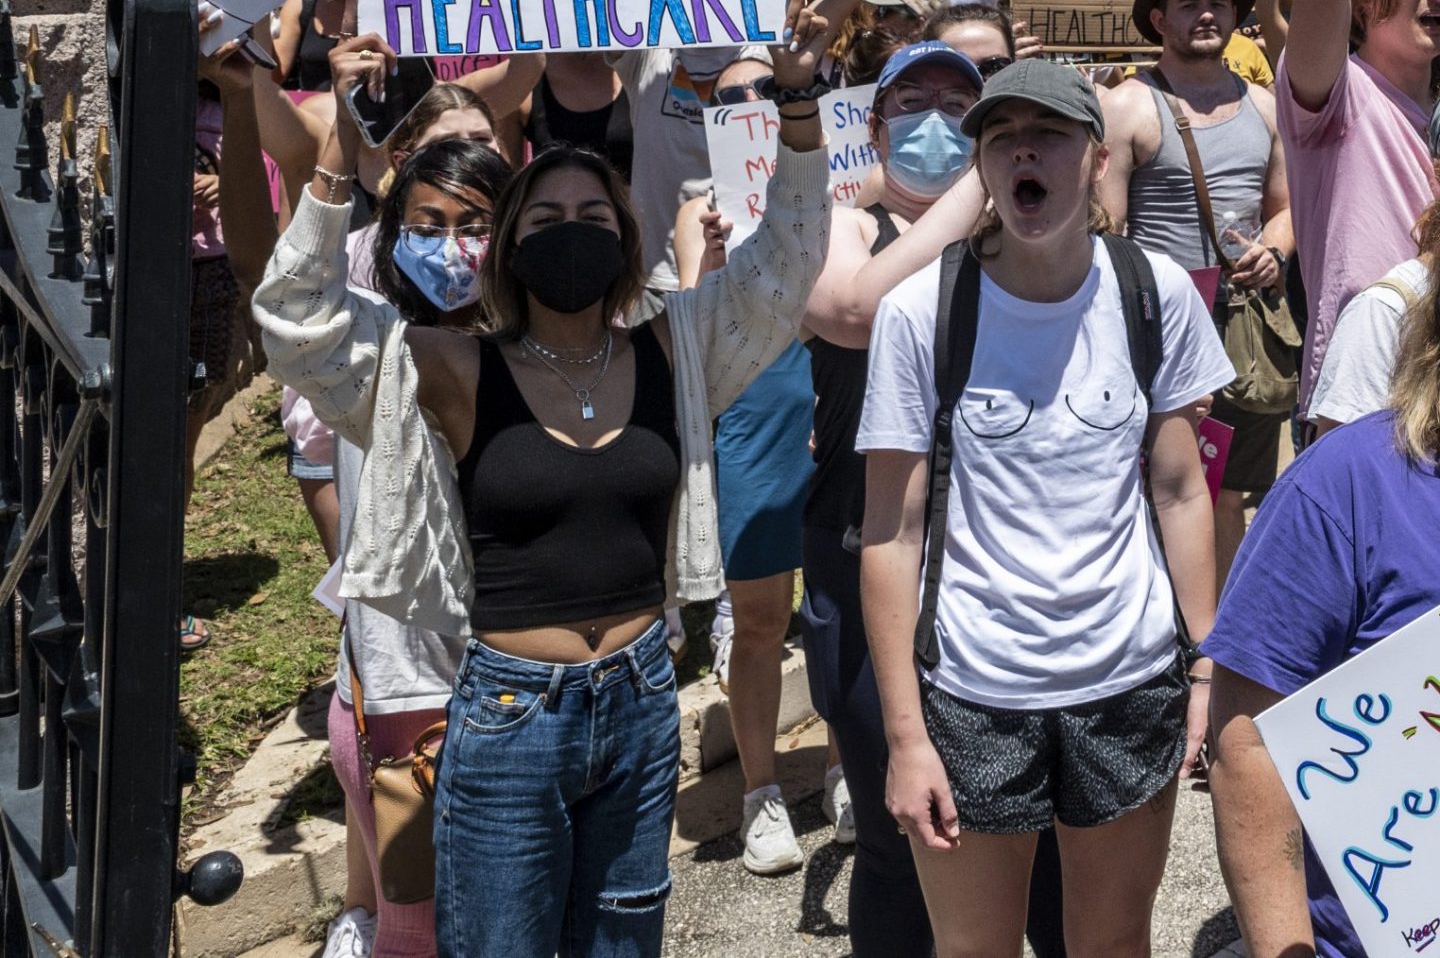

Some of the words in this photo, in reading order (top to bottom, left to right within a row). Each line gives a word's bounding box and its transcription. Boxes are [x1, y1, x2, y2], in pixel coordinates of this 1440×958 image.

[1296, 691, 1393, 800] We
[1341, 786, 1440, 923] Are
[1401, 917, 1440, 948] Keep
